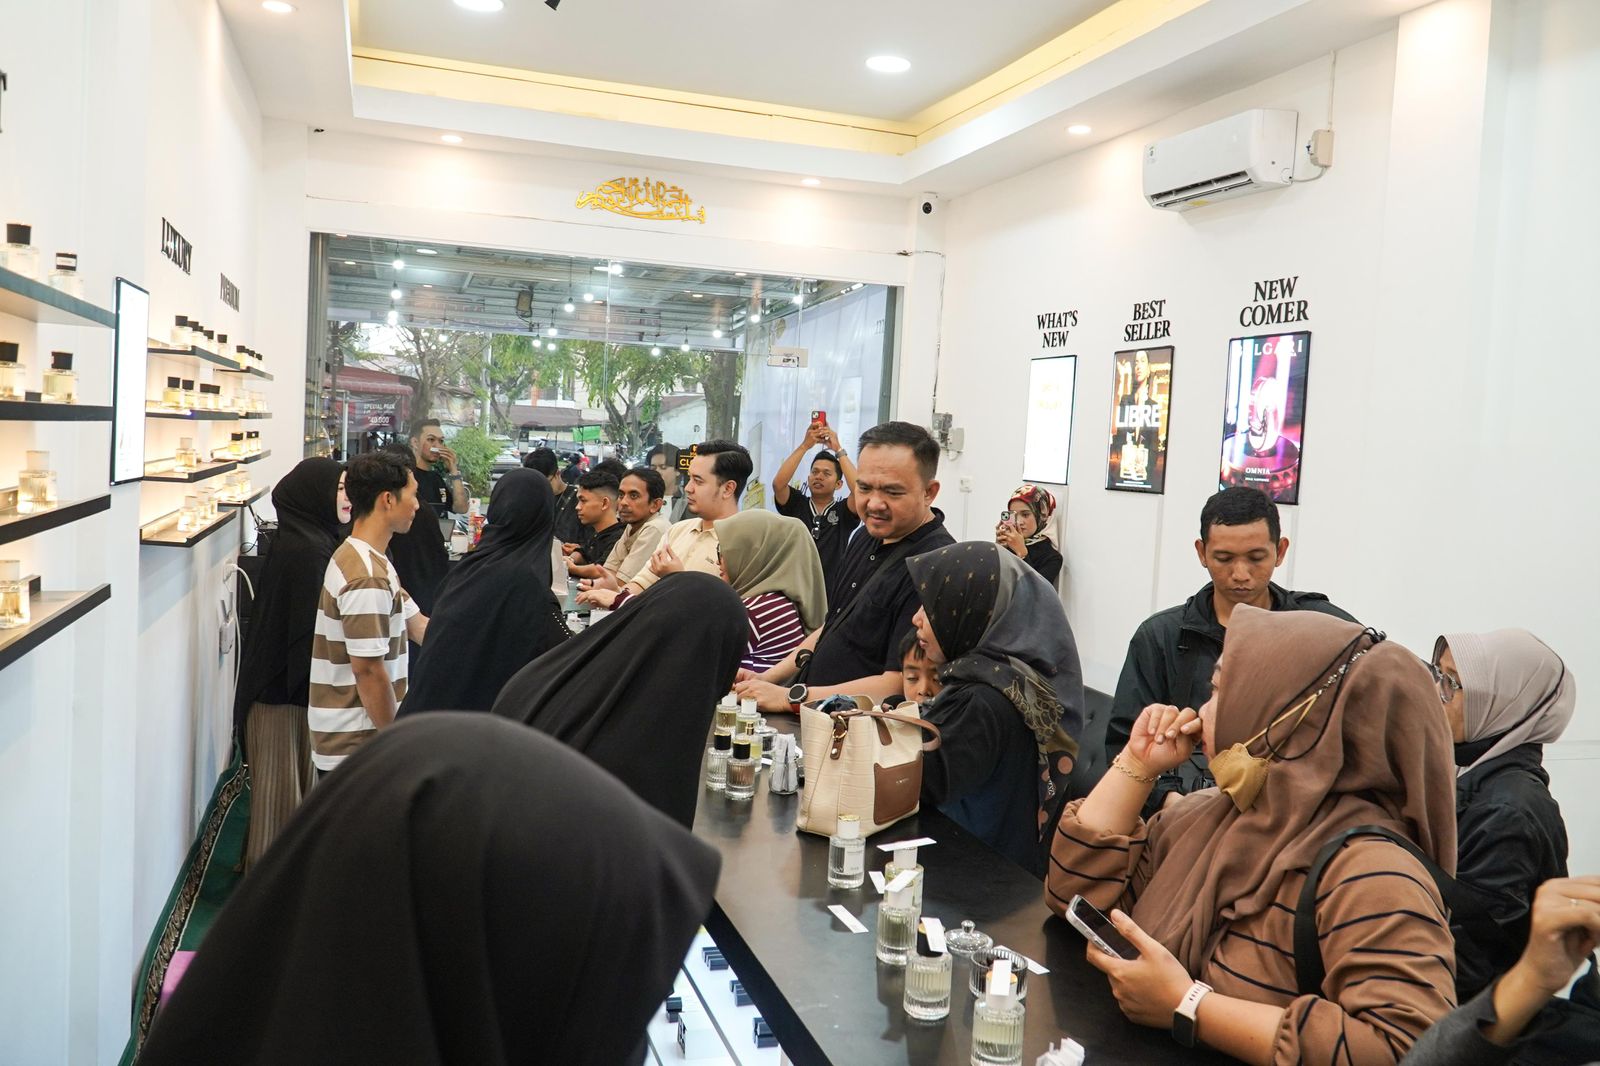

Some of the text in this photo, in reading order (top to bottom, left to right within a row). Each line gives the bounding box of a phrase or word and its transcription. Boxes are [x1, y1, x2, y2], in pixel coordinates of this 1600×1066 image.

[161, 217, 193, 276] LUXURY
[1253, 276, 1299, 302] NEW
[1036, 309, 1079, 330] WHAT'S
[1132, 299, 1166, 321] BEST
[1239, 300, 1309, 328] COMER
[1042, 330, 1070, 348] NEW
[1123, 319, 1171, 342] SELLER
[1115, 404, 1161, 428] LIBRE
[1245, 467, 1271, 475] OMNIA
